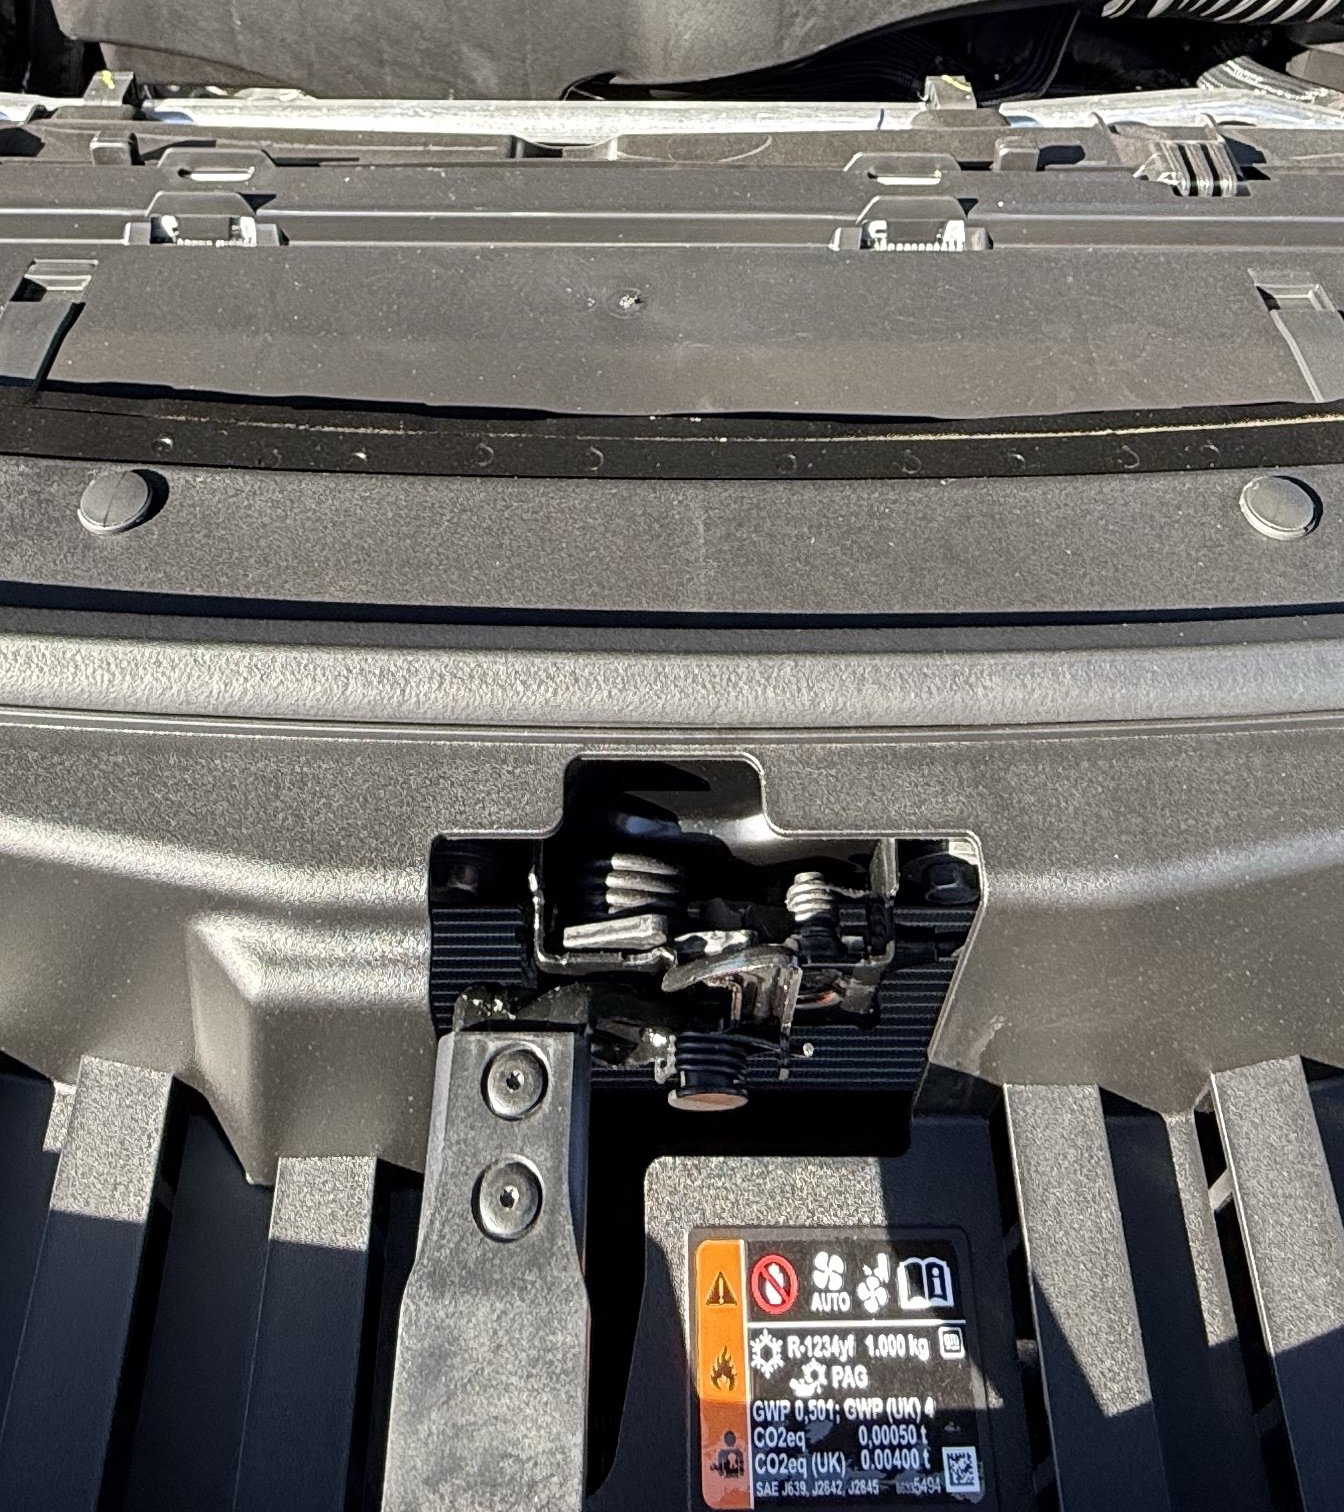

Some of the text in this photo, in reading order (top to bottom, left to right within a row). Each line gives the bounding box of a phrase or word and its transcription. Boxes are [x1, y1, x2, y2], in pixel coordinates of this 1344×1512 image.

[810, 1291, 851, 1312] AUTO
[787, 1334, 930, 1362] R-1234yf 1.000 kg
[831, 1365, 868, 1389] PAG
[753, 1396, 935, 1424] GWP 0,501; GWP (UK) 4
[753, 1425, 928, 1451] CO2eq 0,00050 t
[755, 1448, 931, 1479] CO2eq (UK) 0.00400 t
[756, 1481, 779, 1496] SAE
[782, 1481, 809, 1498] J639,
